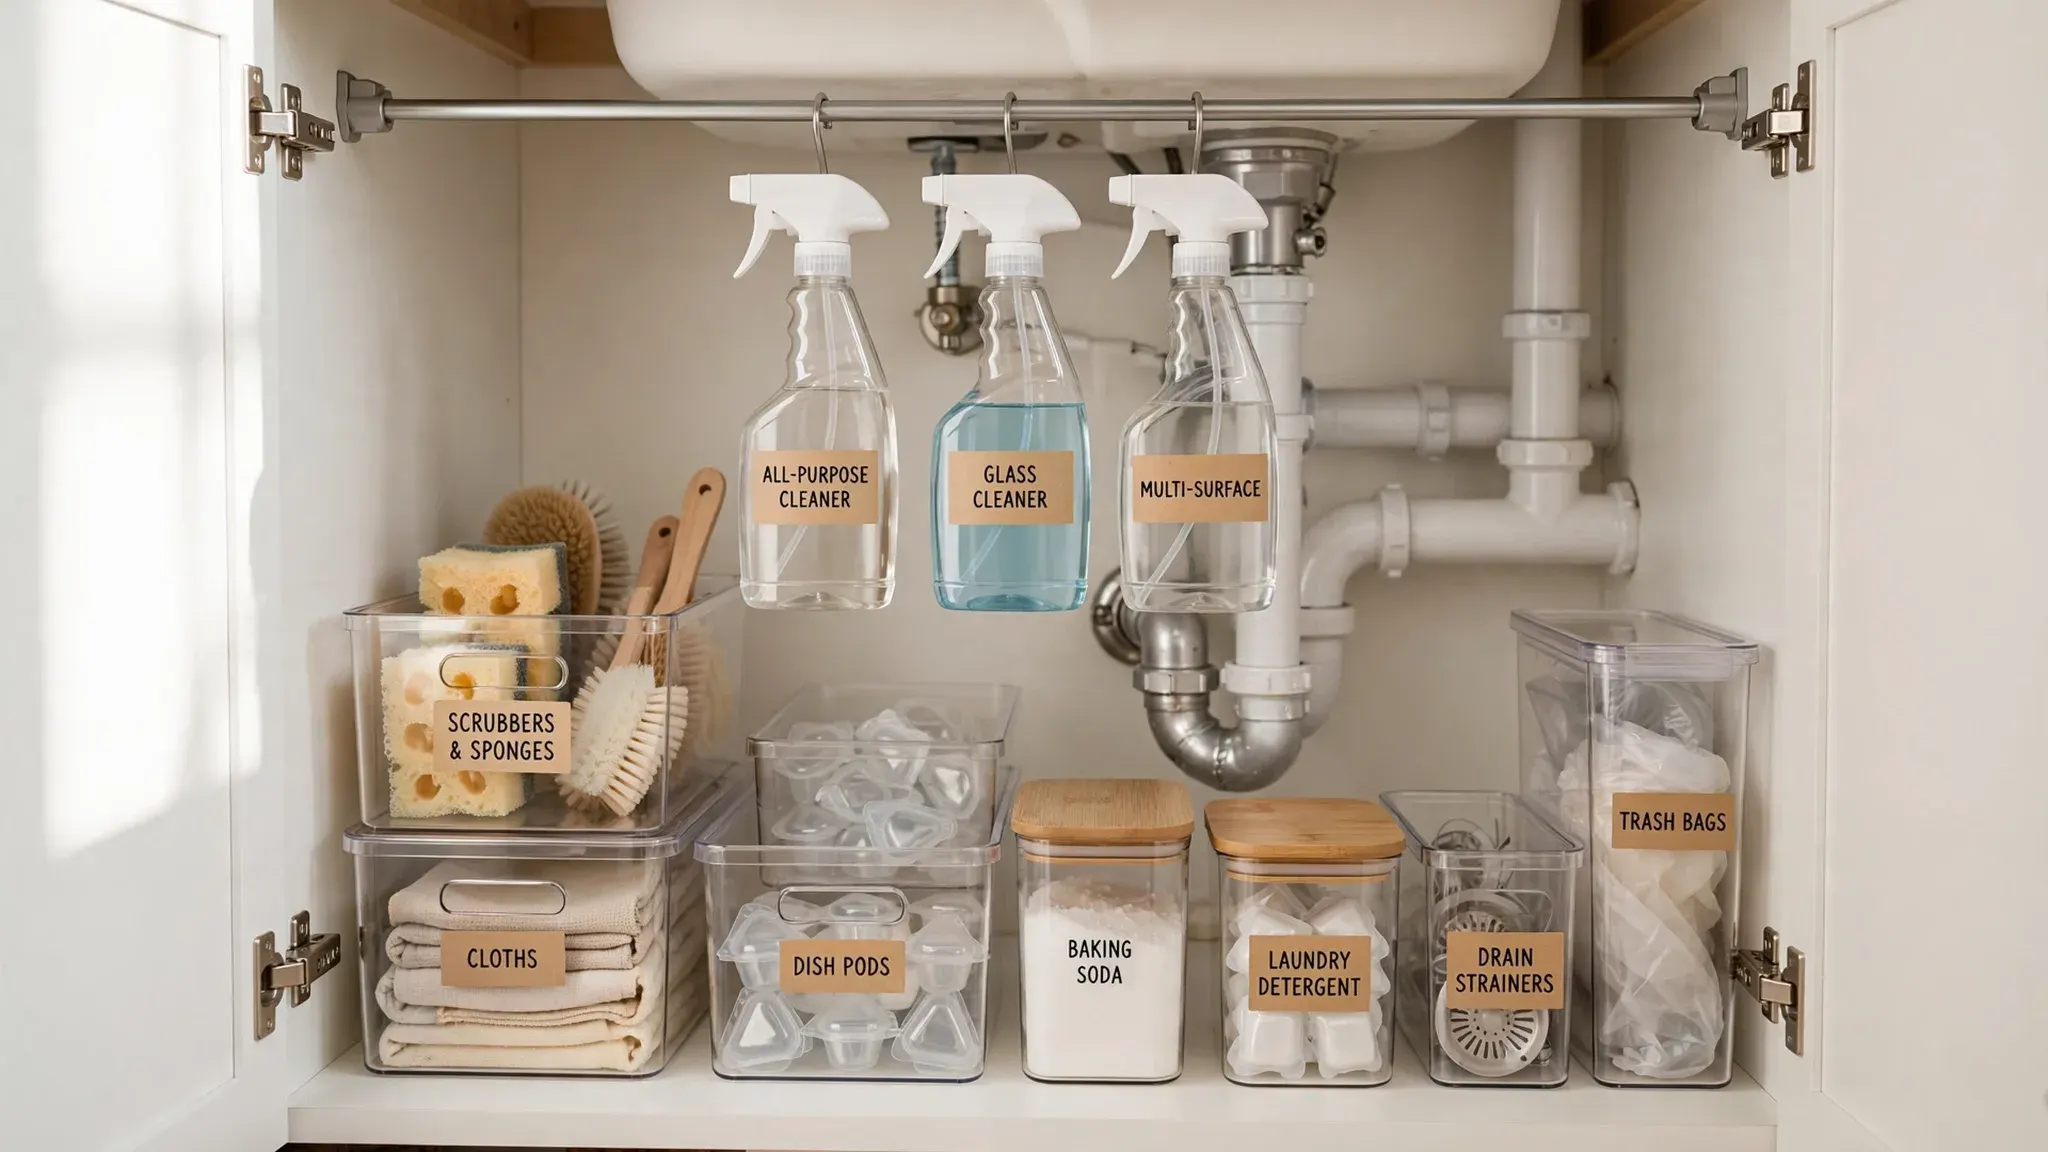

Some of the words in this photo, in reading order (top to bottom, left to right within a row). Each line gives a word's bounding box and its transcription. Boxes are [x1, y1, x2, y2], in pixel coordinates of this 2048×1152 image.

[763, 465, 869, 484] ALL-PURPOSE
[983, 464, 1037, 484] GLASS
[779, 490, 851, 508] CLEANER
[973, 490, 1048, 509] CLEANER
[1140, 480, 1262, 498] MULTI-SURFACE
[448, 711, 555, 734] SCRUBBERS
[449, 739, 462, 761] &
[470, 739, 555, 761] SPONGES
[1619, 811, 1676, 832] TRASH
[1682, 811, 1727, 832] BAGS
[466, 947, 538, 969] CLOTHS
[1068, 939, 1132, 959] BAKING
[1478, 946, 1534, 968] DRAIN
[793, 956, 835, 977] DISH
[843, 956, 890, 977] PODS
[1269, 950, 1352, 971] LAUNDRY
[1076, 965, 1123, 984] SODA
[1455, 973, 1554, 994] STRAINERS
[1258, 976, 1362, 997] DETERGENT
